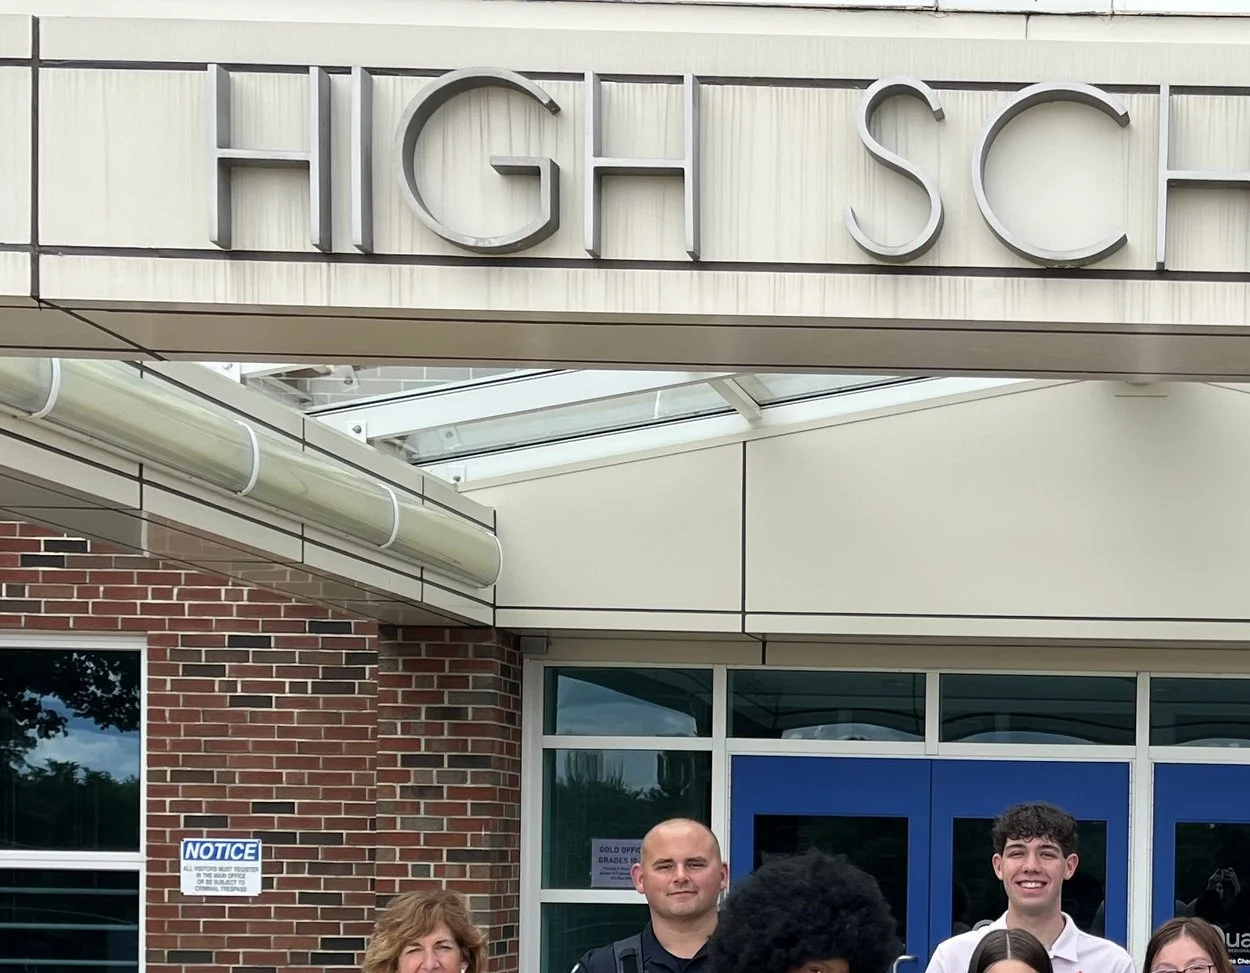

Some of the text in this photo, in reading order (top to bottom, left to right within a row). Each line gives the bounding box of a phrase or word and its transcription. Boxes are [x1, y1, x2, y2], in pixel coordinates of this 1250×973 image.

[206, 63, 702, 263] HIGH
[185, 842, 258, 860] NOTICE
[600, 846, 620, 854] GOLD
